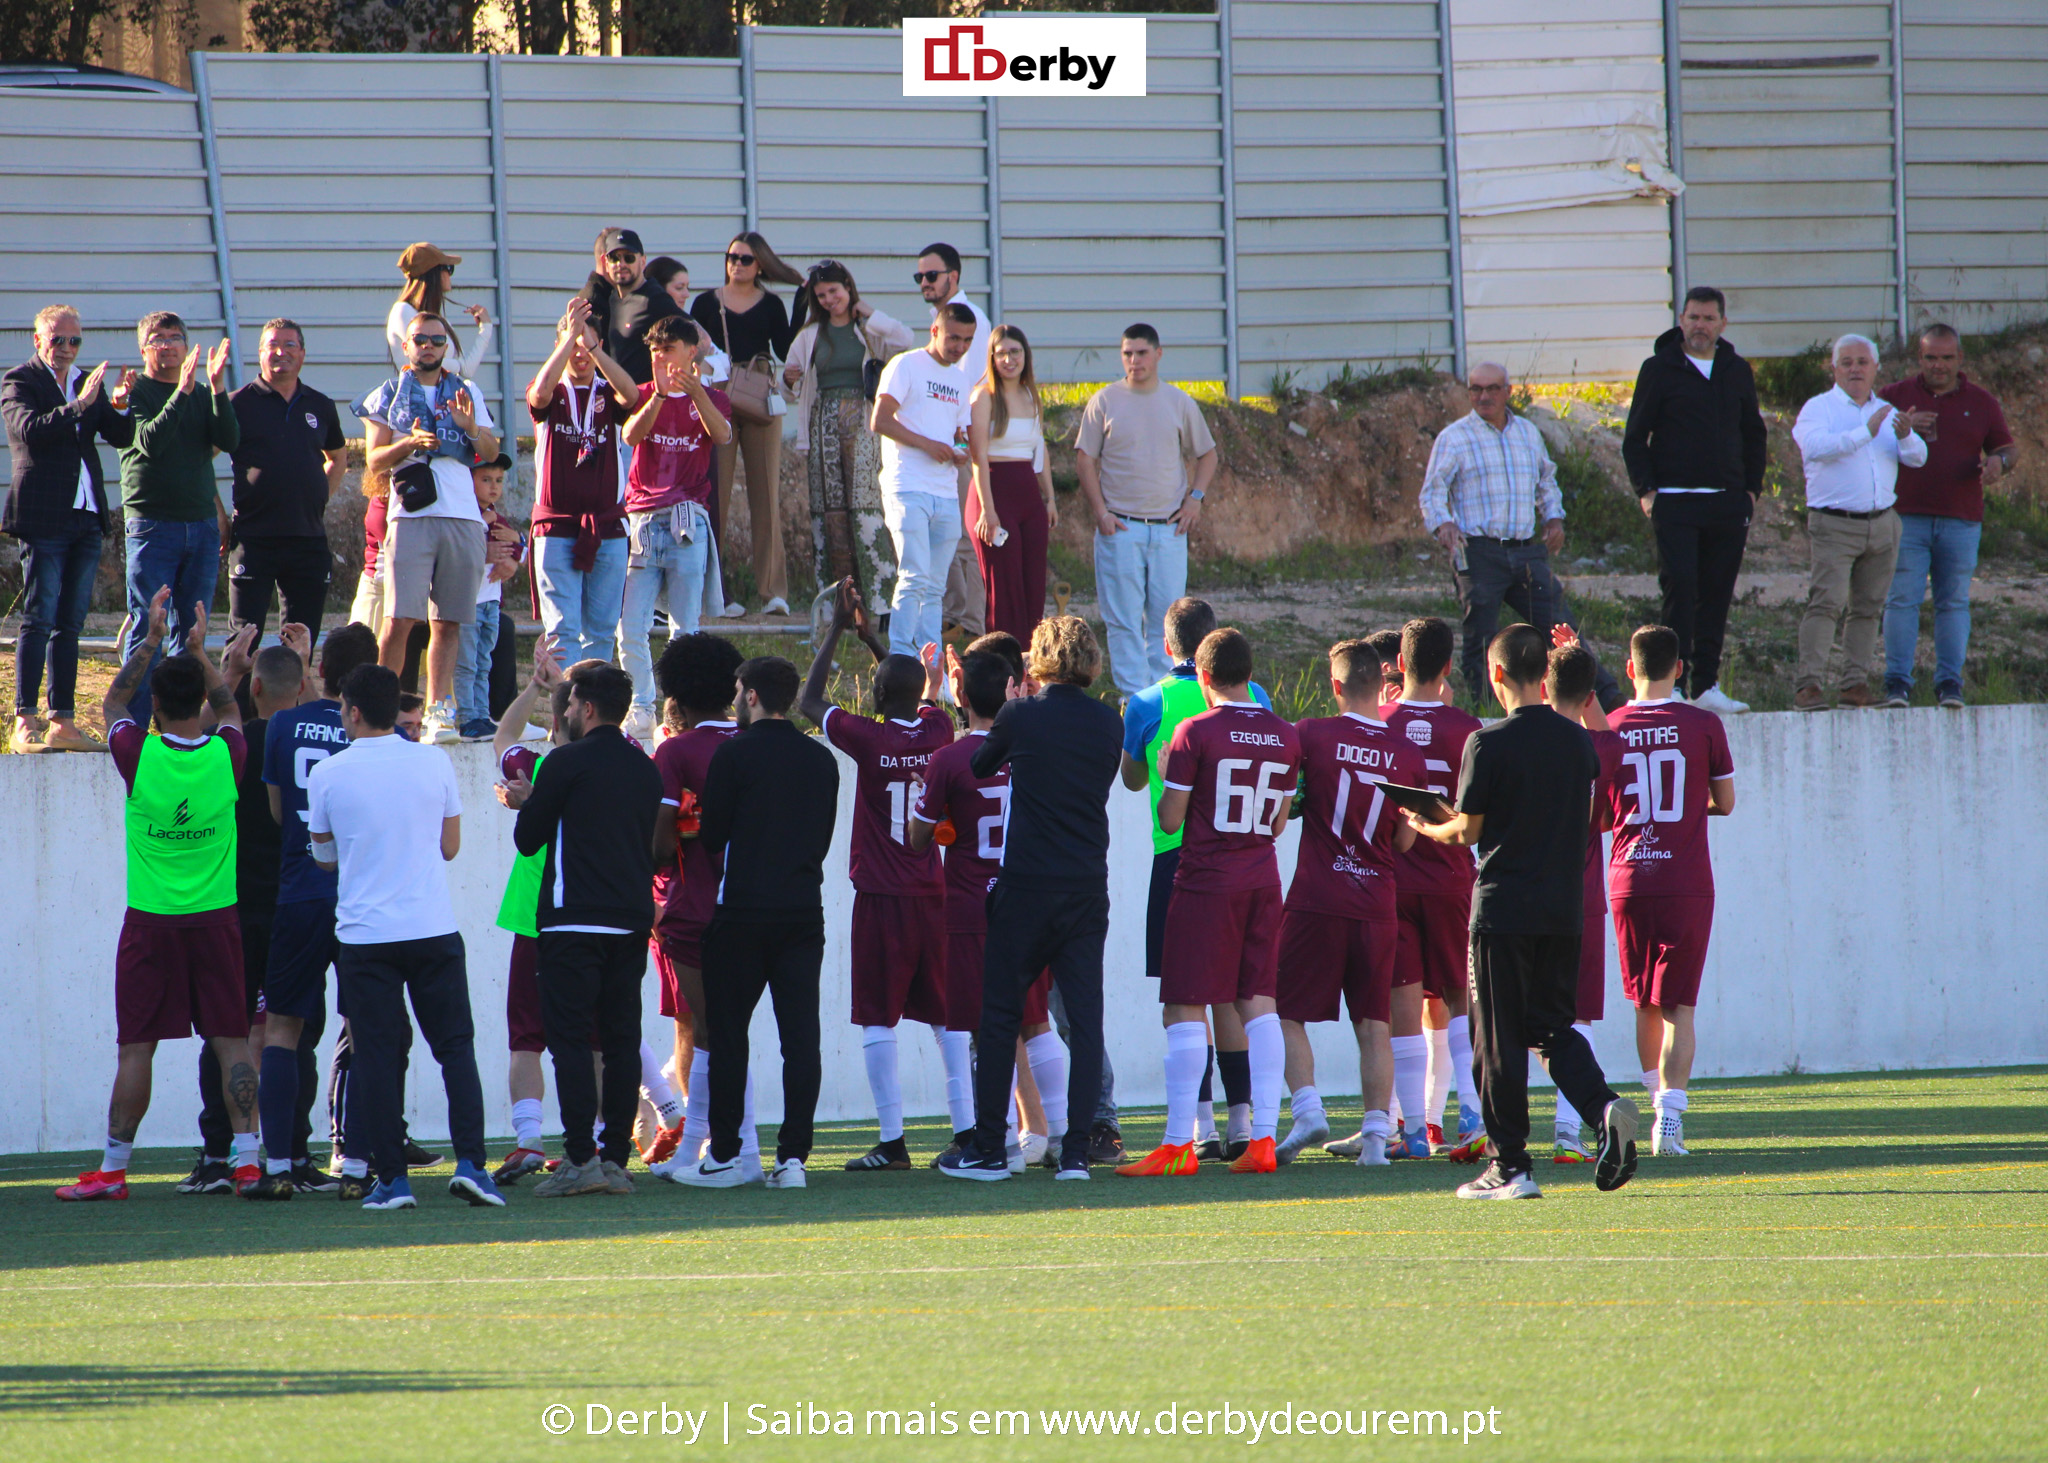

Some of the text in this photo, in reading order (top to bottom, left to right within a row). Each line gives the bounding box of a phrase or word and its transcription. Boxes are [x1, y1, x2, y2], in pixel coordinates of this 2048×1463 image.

[926, 380, 960, 399] TOMMY
[293, 722, 353, 745] FRANC
[1229, 731, 1285, 748] EZEQUIEL
[1406, 733, 1432, 741] KING
[1619, 725, 1679, 748] MATIAS
[880, 753, 933, 769] DA TCHU
[1336, 743, 1398, 771] DIOGO V.
[1213, 758, 1291, 836] 66
[1621, 748, 1686, 825] 30
[1331, 767, 1389, 846] 17
[147, 823, 216, 840] Lacatoni
